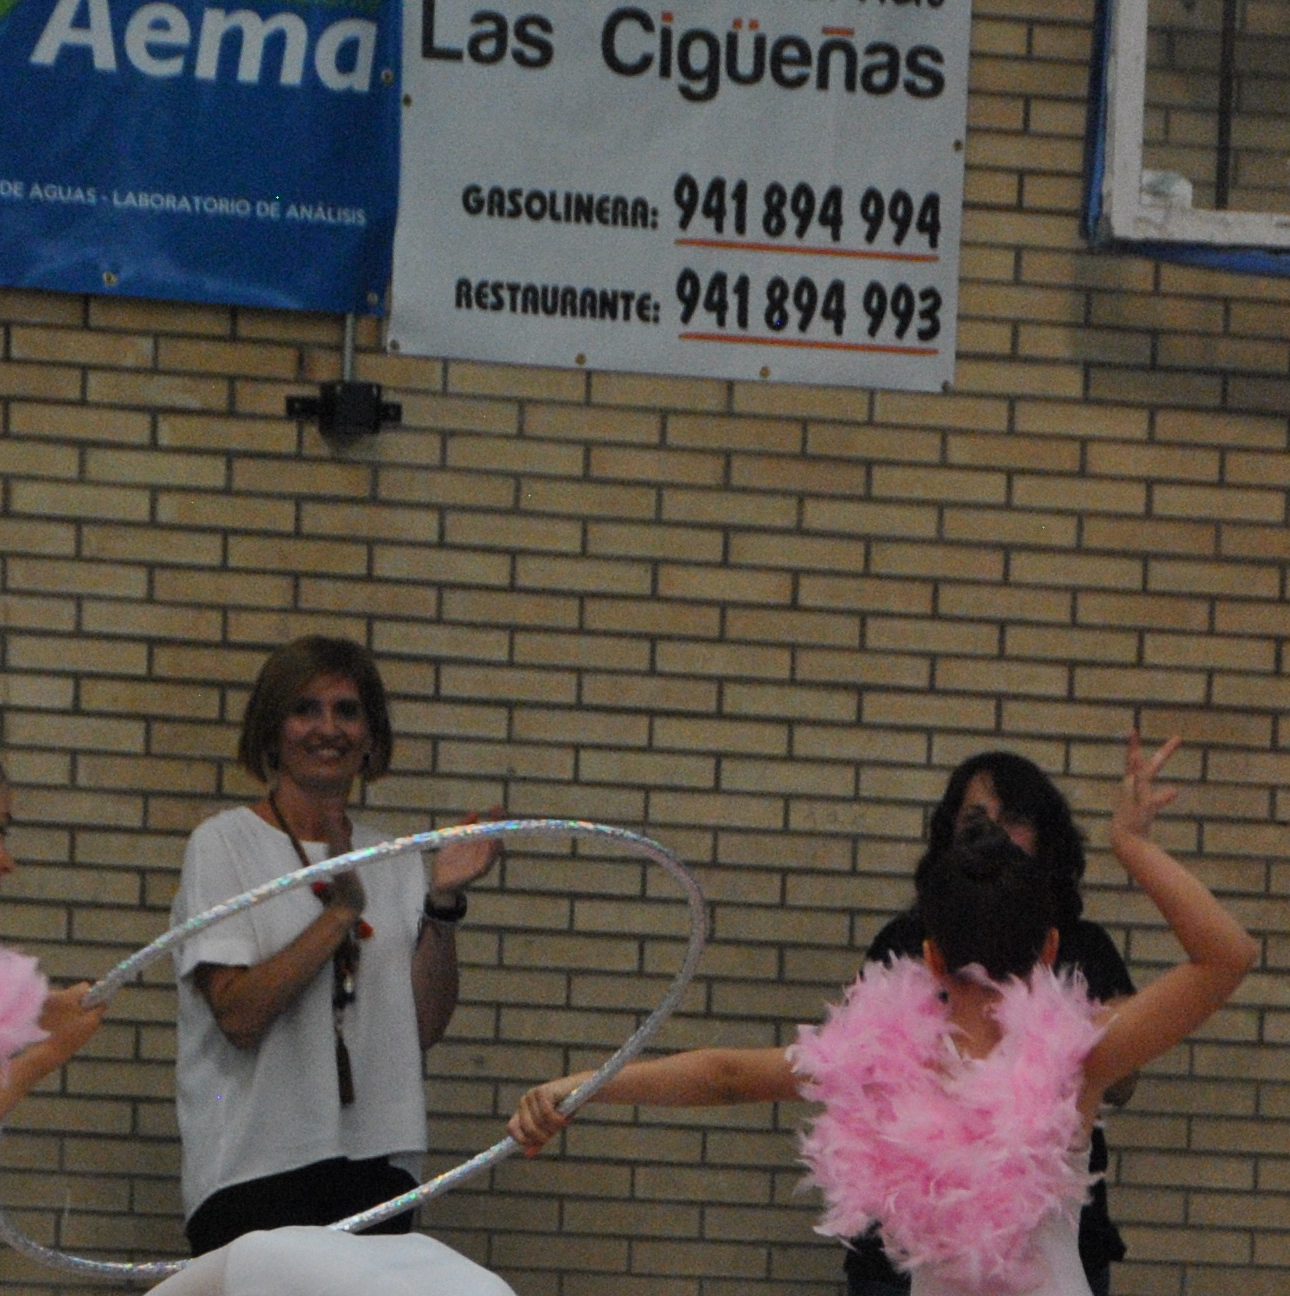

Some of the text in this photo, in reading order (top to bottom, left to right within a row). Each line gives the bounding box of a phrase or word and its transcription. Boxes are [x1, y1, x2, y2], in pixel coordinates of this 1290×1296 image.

[29, 0, 377, 92] Aema
[421, 0, 946, 101] Las Cigüeñas
[0, 179, 25, 198] DE
[29, 181, 97, 206] AGUAS
[112, 189, 250, 218] LABORATORIO
[255, 200, 281, 219] DE
[461, 172, 942, 249] GASOLINERA: 941 894 994
[454, 267, 943, 342] RESTAURANTE: 941 894 993
